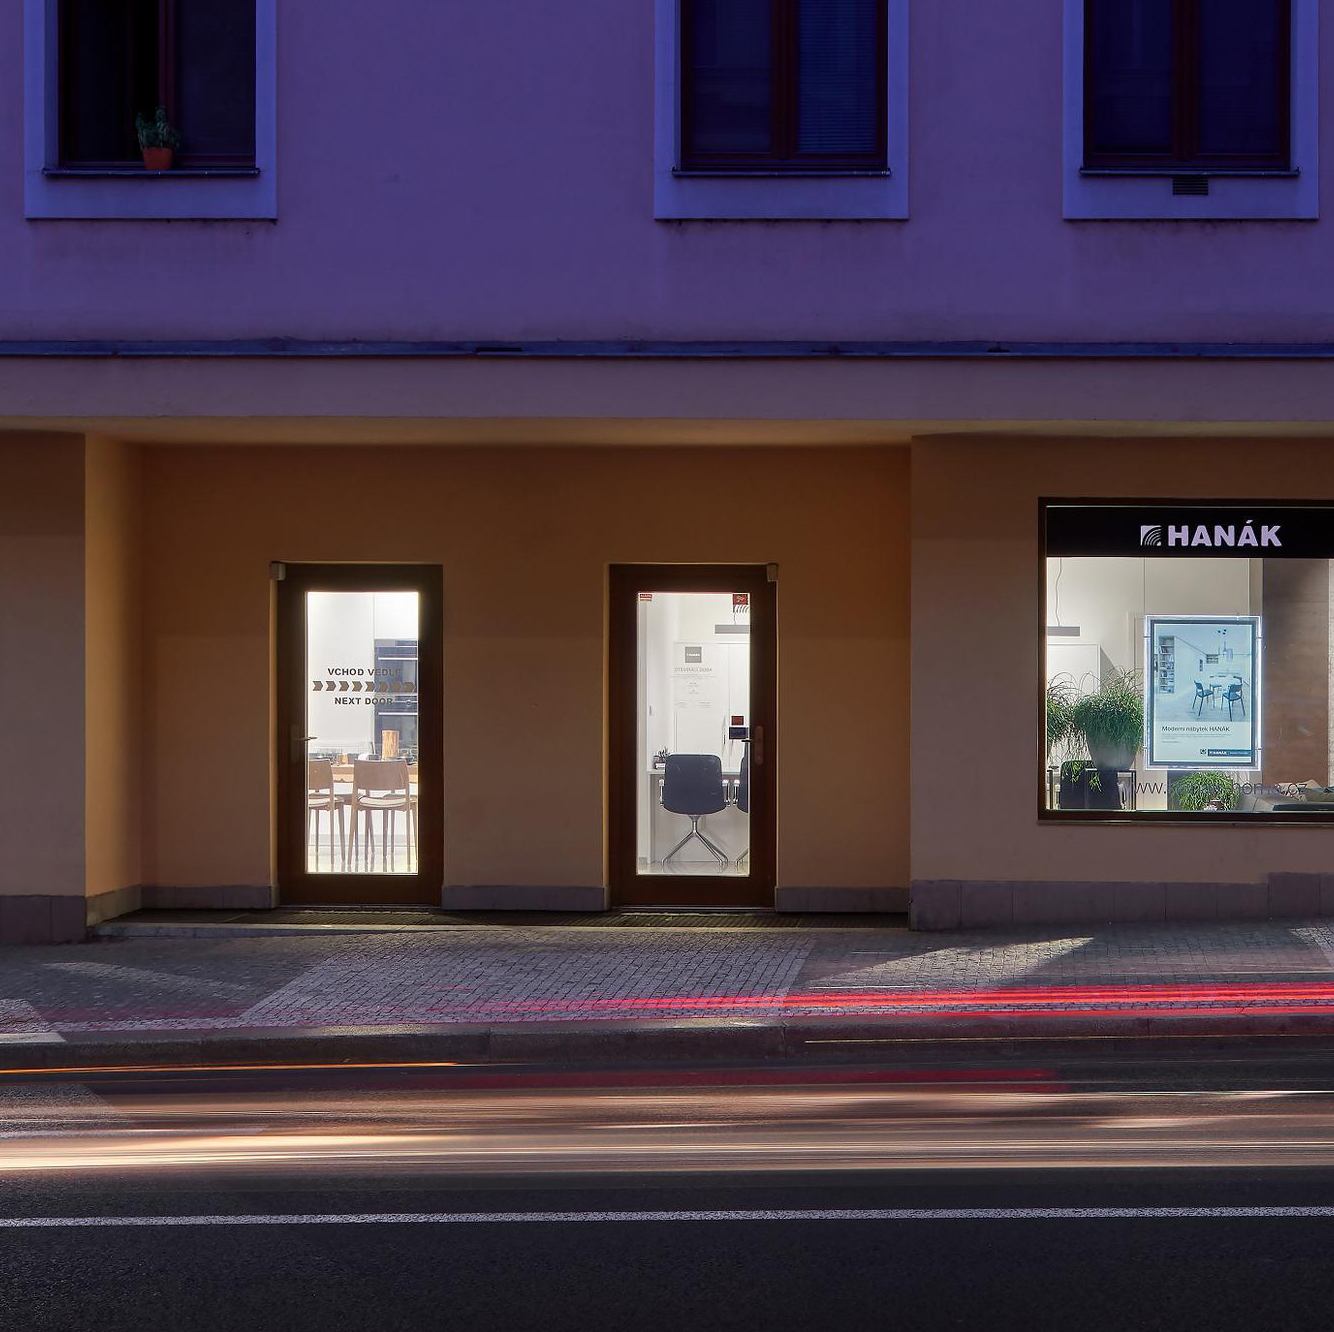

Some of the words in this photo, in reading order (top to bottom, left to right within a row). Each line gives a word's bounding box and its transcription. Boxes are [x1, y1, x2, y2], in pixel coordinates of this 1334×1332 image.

[1167, 519, 1282, 547] HANÁK
[327, 668, 364, 676] VCHOD
[334, 697, 361, 705] NEXT
[364, 697, 393, 705] DOOR
